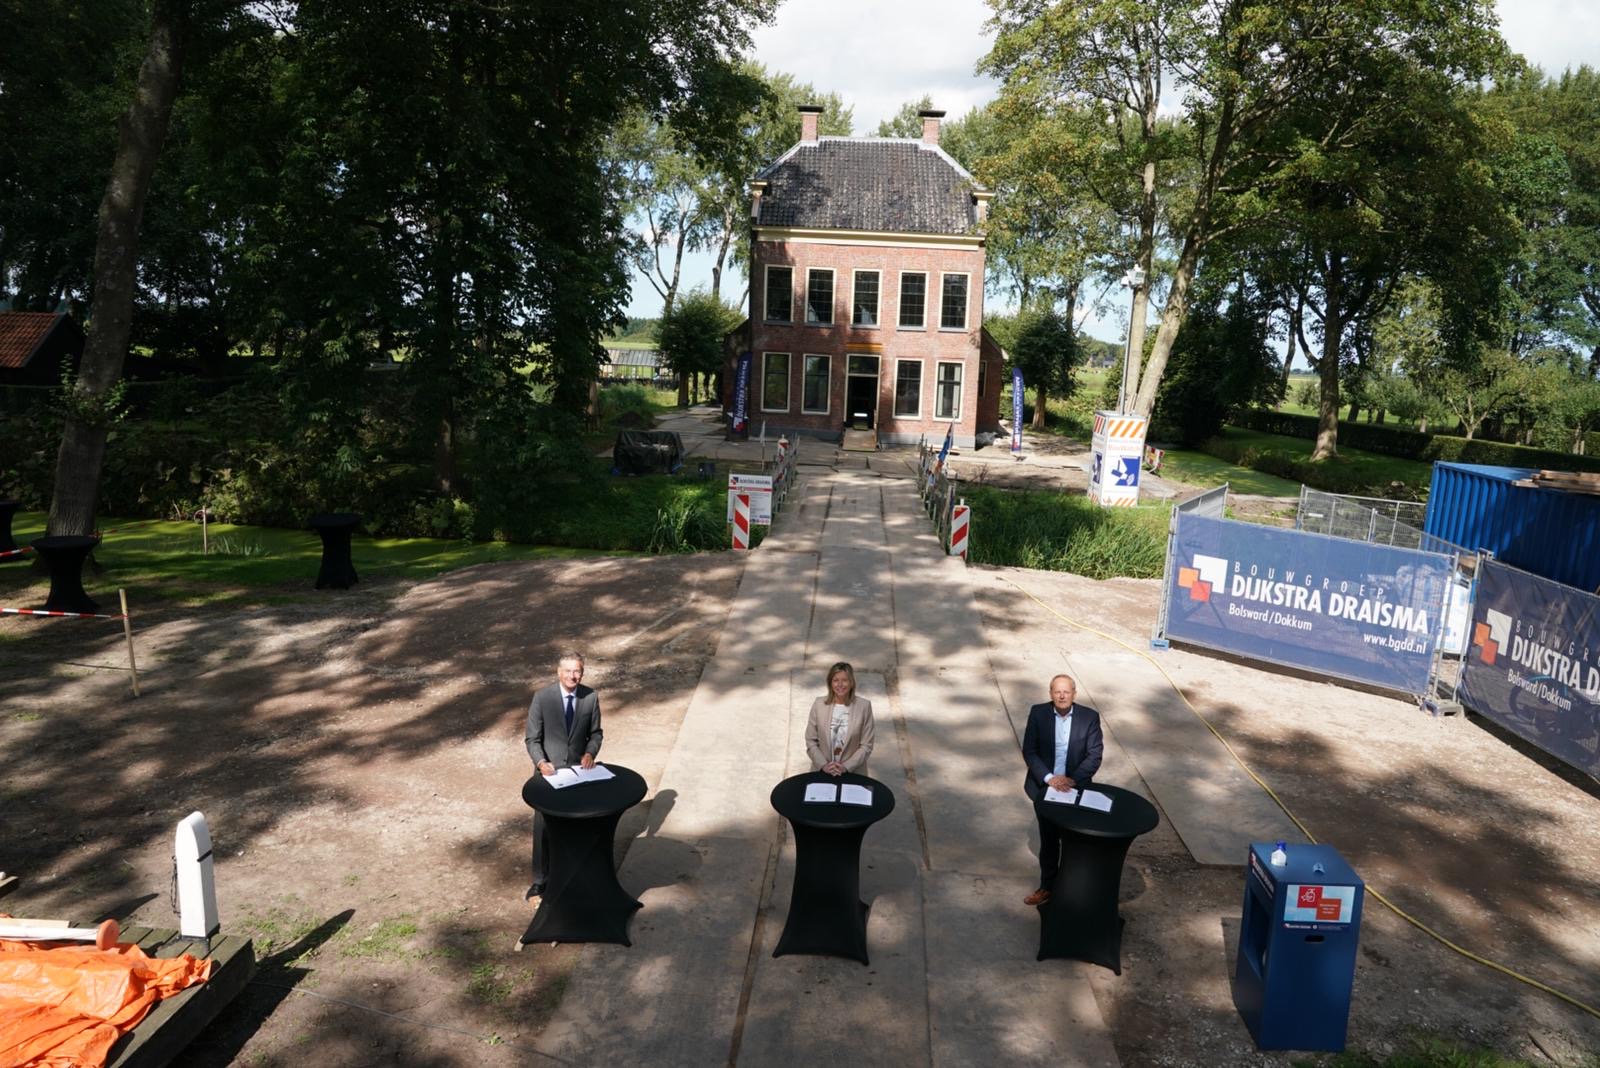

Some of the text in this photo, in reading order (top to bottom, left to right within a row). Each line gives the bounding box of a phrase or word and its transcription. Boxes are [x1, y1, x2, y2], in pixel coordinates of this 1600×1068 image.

[1234, 561, 1384, 599] BOUWGROEP
[1231, 574, 1429, 635] DIJKSTRA DRAISMA
[1363, 632, 1427, 655] www.bgdd.nl
[1511, 635, 1582, 691] DIJKSTRA
